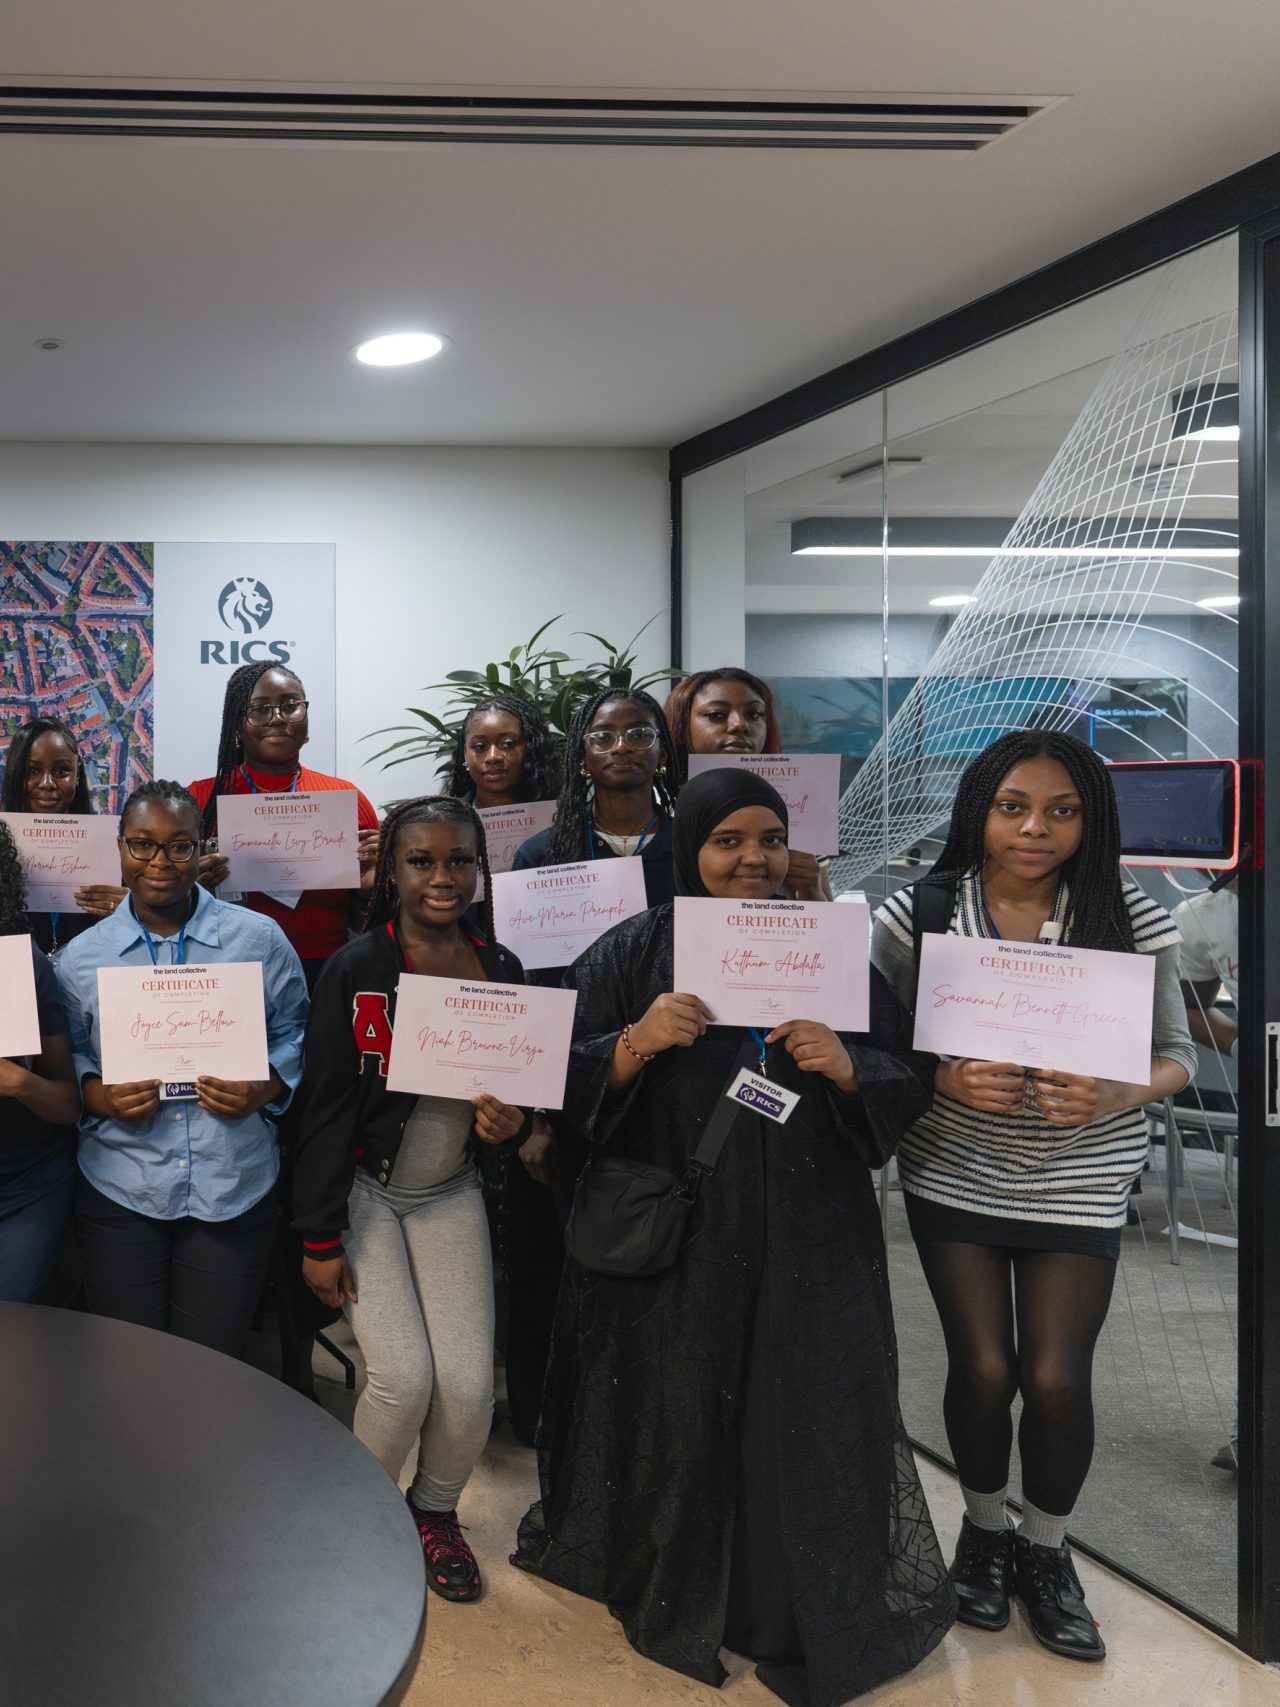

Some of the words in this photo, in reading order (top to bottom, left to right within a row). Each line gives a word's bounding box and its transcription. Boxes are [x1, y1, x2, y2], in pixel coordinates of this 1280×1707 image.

[200, 640, 291, 664] RICS
[254, 803, 321, 815] CERTIFICATE
[22, 828, 88, 839] CERTIFICATE
[560, 863, 588, 873] collective
[526, 873, 600, 891] CERTIFICATE
[579, 898, 626, 923] Prempeh
[754, 902, 770, 910] land
[771, 903, 805, 911] collective
[726, 914, 818, 929] CERTIFICATE
[998, 945, 1012, 954] the
[1013, 946, 1031, 955] land
[1032, 949, 1073, 960] collective
[164, 967, 178, 975] land
[774, 950, 825, 977] Abdalla
[980, 956, 1088, 980] CERTIFICATE
[142, 978, 219, 991] CERTIFICATE
[471, 986, 486, 994] land
[486, 988, 517, 997] collective
[932, 984, 1007, 1010] Savannah
[445, 996, 528, 1015] CERTIFICATE
[130, 1012, 163, 1041] Joyce
[750, 1078, 783, 1098] VISITOR
[755, 1096, 782, 1112] RICS
